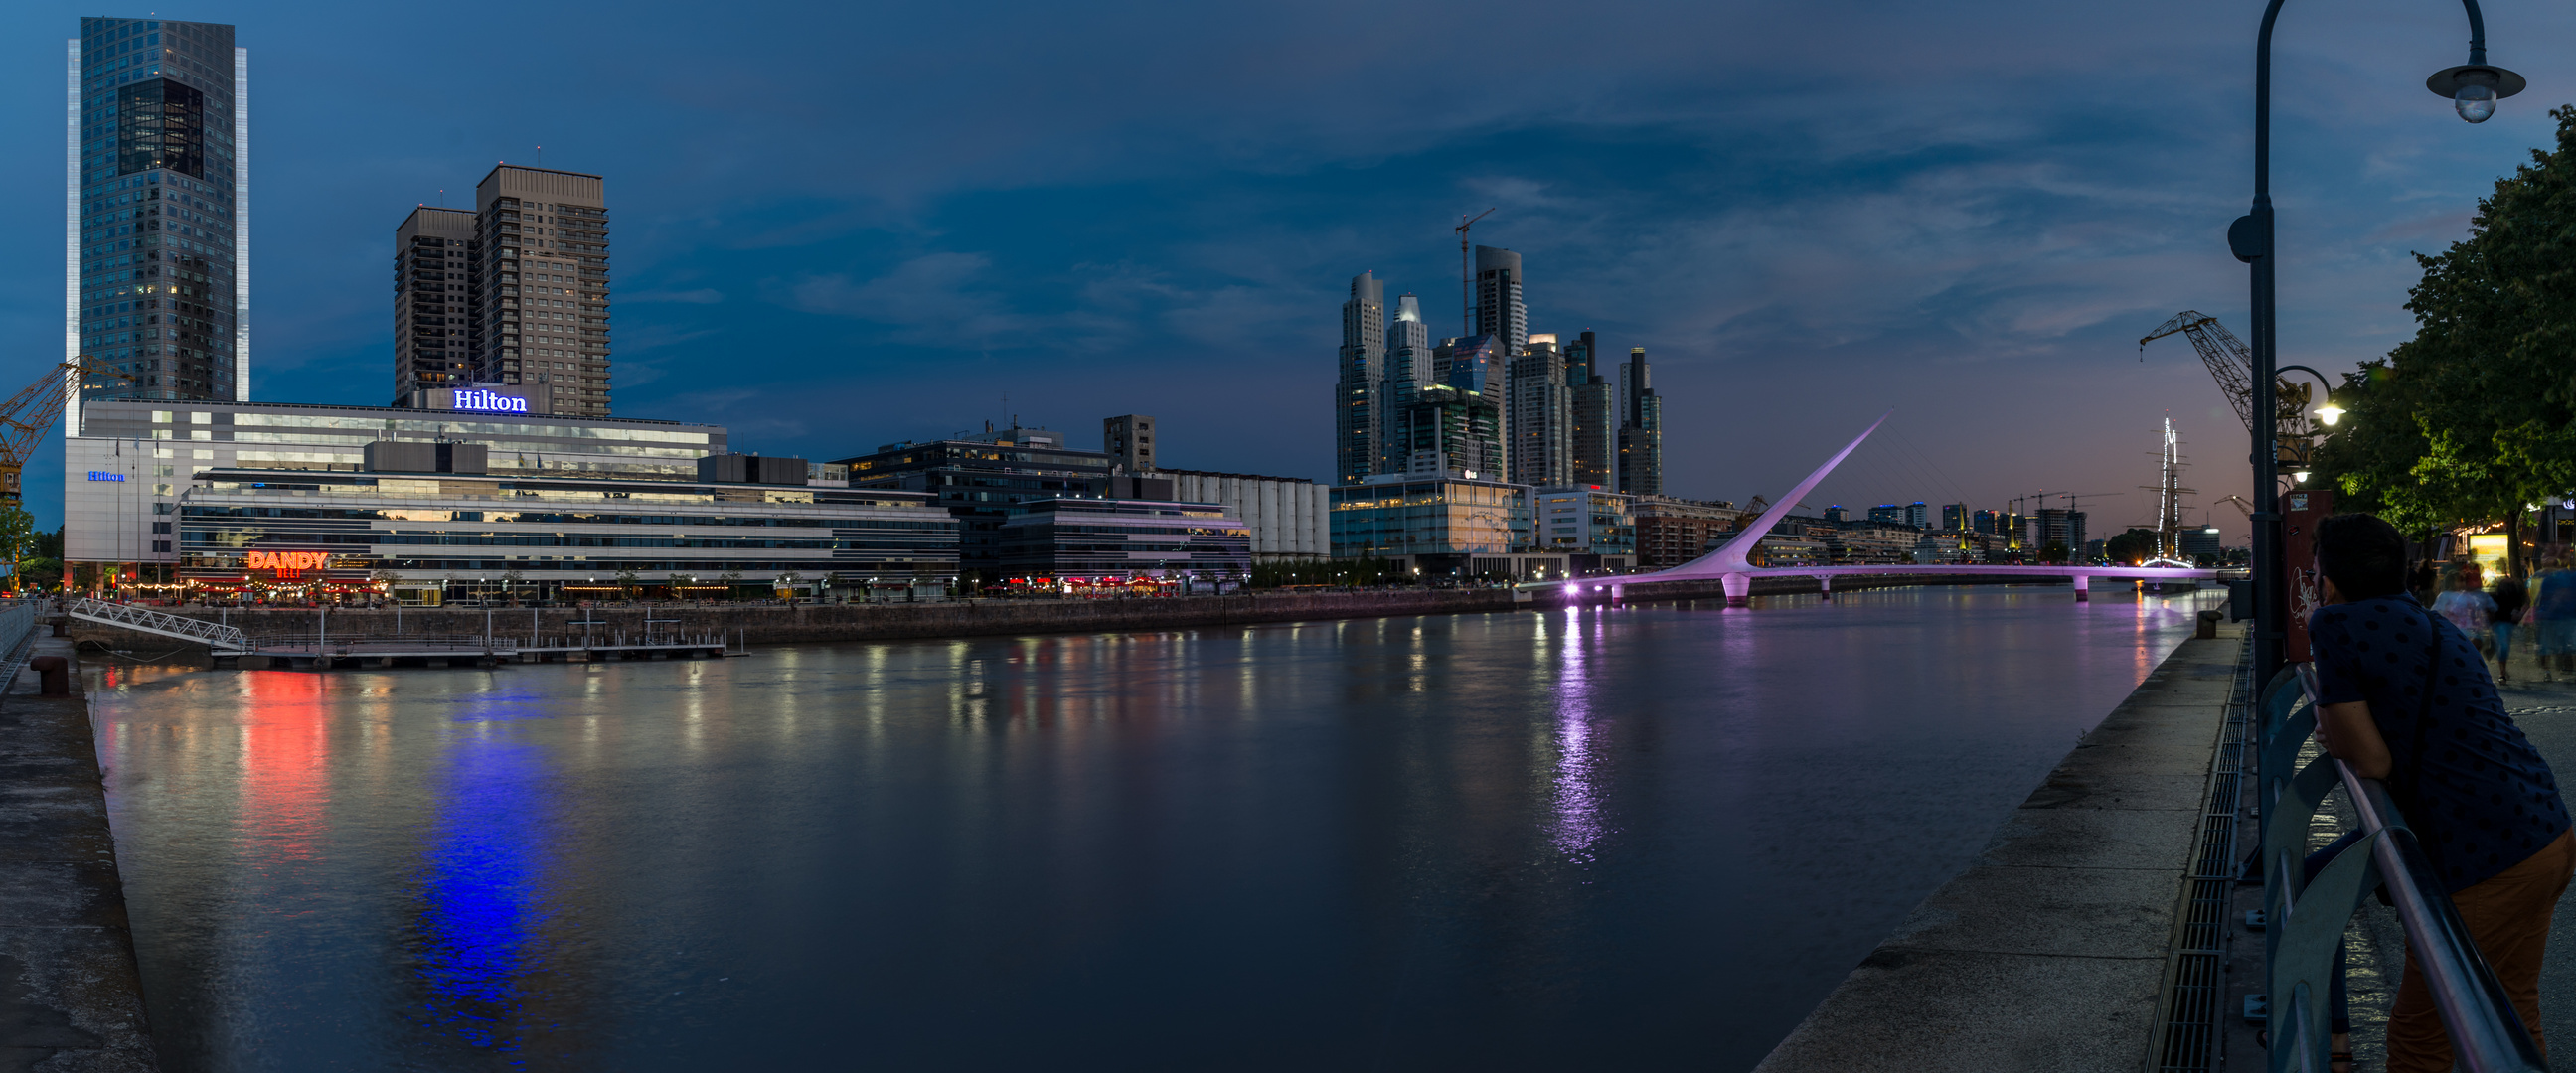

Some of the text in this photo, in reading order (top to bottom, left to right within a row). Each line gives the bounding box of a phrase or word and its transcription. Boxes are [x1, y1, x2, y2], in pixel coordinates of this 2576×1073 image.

[454, 389, 527, 412] Hilton
[88, 471, 125, 482] Hilton
[248, 551, 328, 569] DANDY
[276, 568, 300, 578] DELI
